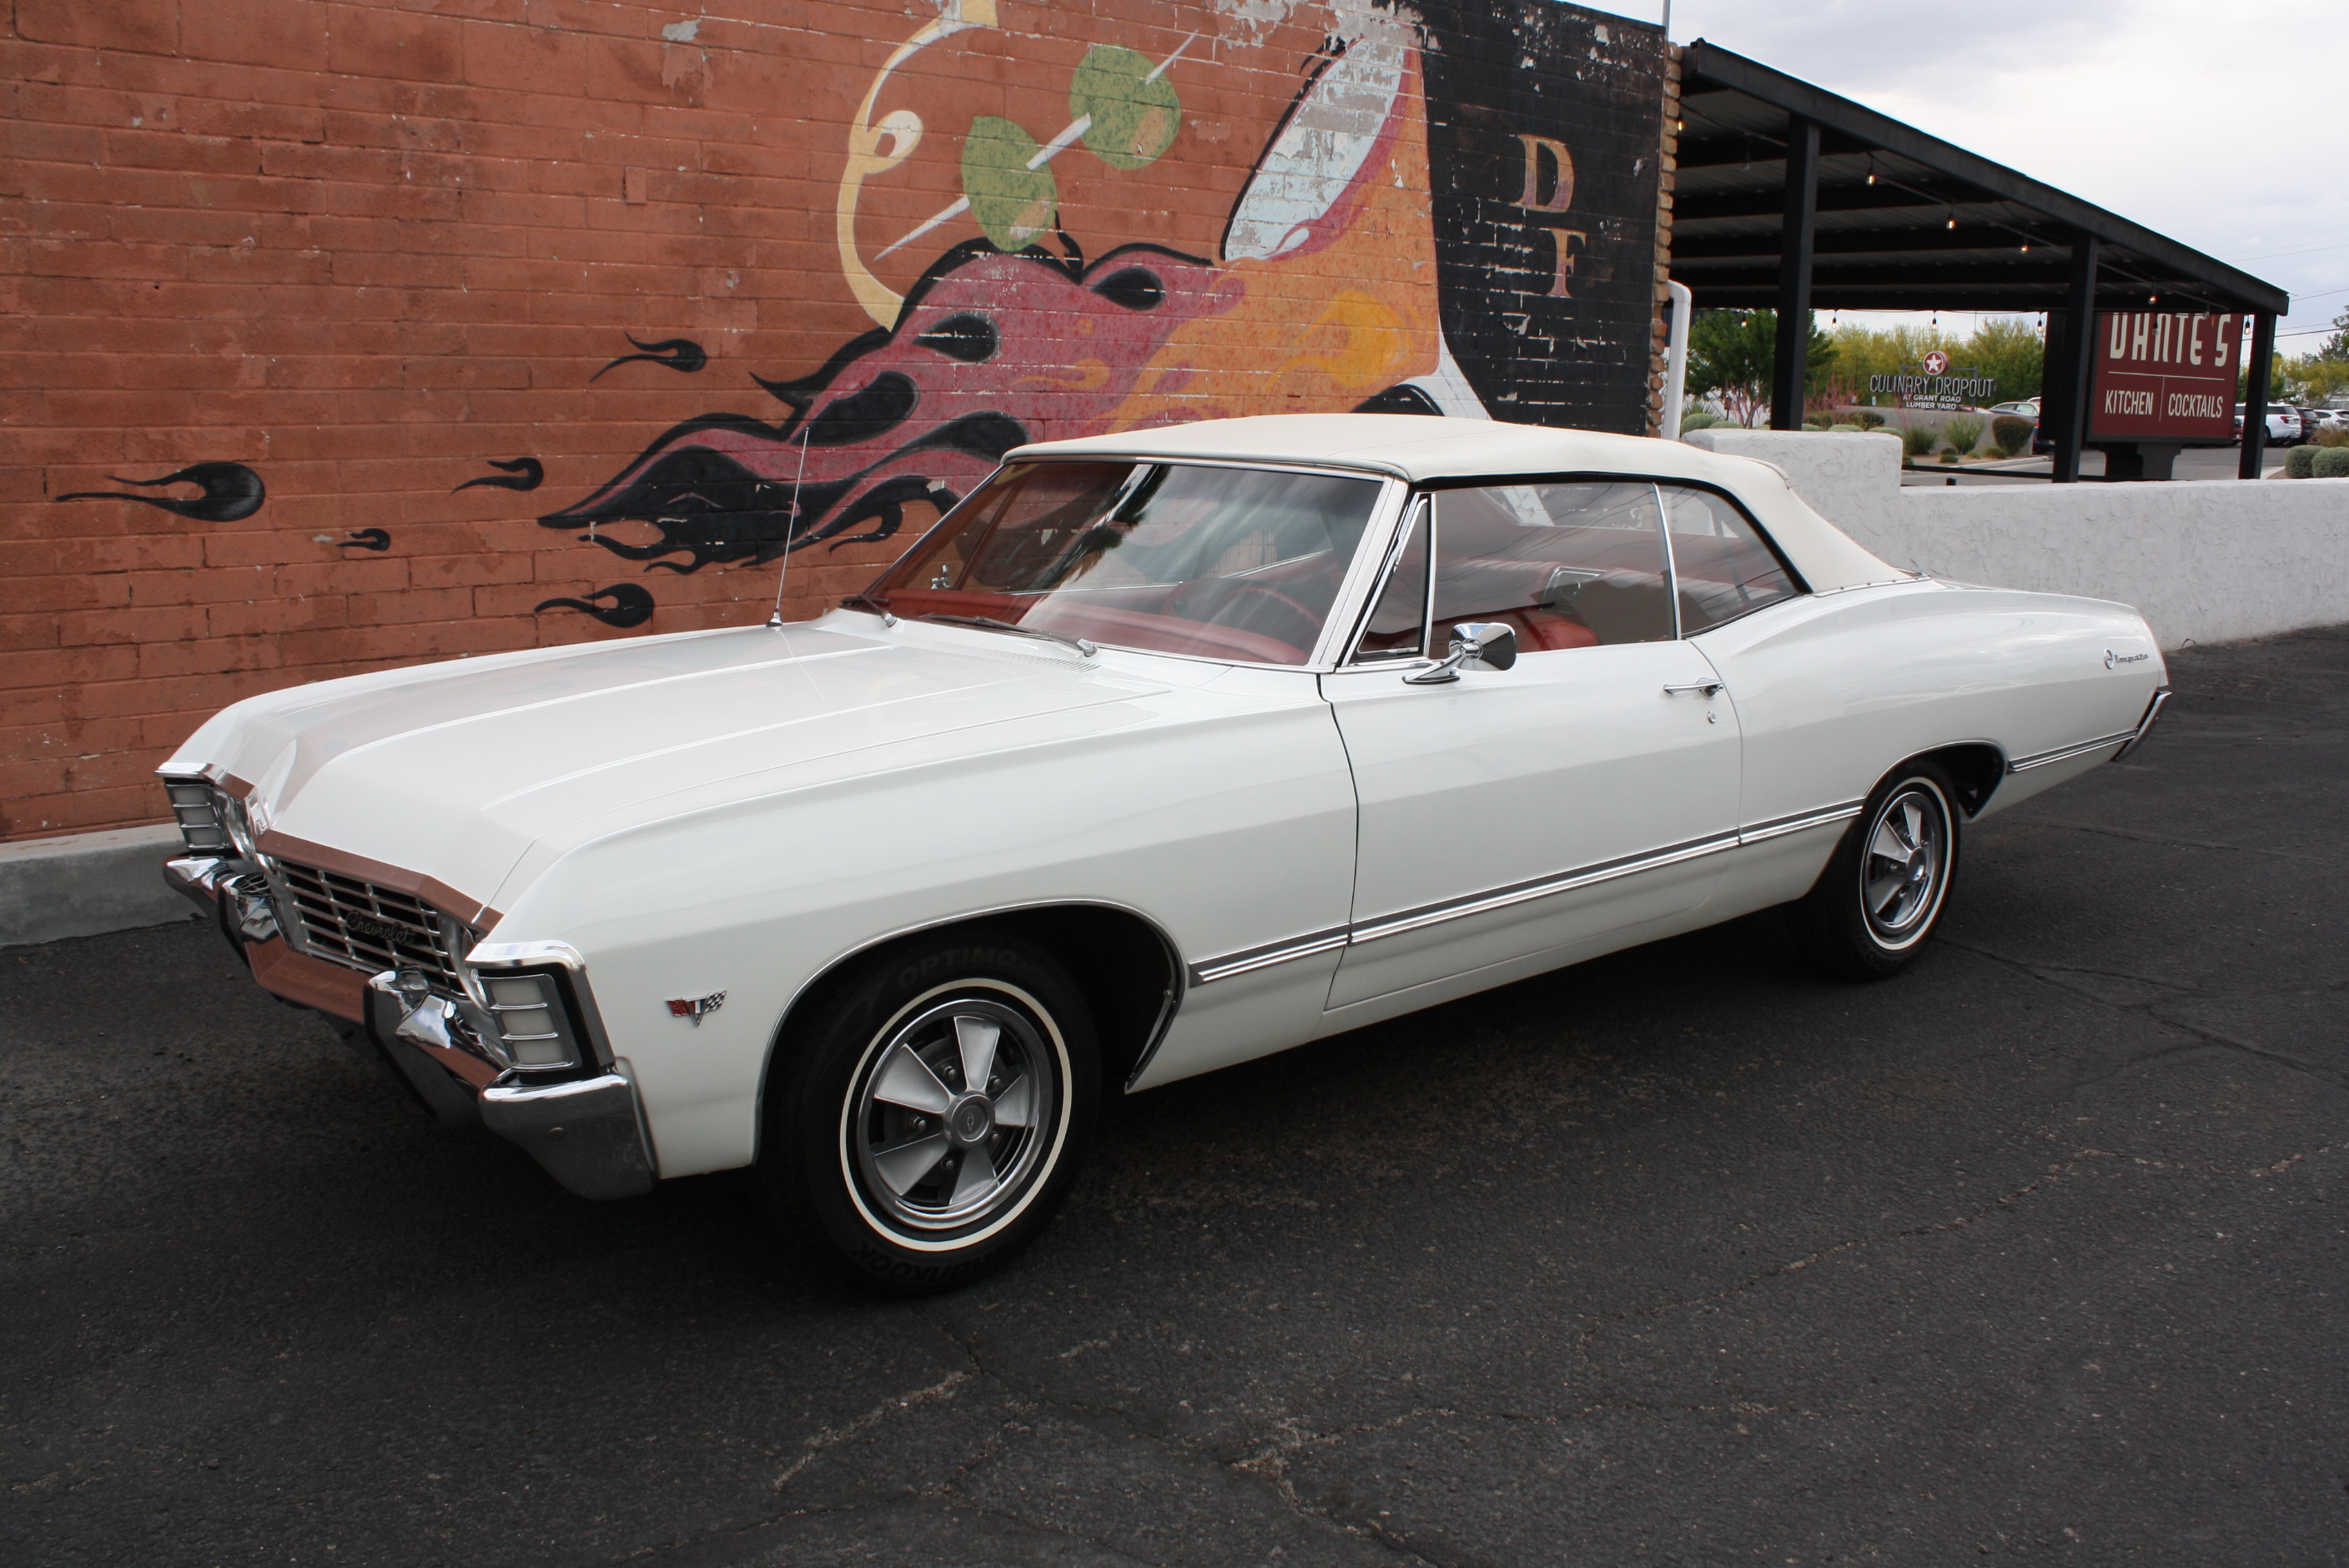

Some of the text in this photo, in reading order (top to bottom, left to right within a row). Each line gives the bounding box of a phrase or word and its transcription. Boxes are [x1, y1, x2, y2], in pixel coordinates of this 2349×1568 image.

[1509, 133, 1575, 213] D
[1547, 228, 1587, 299] F
[1870, 375, 1994, 397] CULINARY DROPOUT
[2105, 389, 2223, 418] KITCHEN COCKTAILS
[346, 910, 415, 944] Chevrolet
[898, 946, 1017, 989] OPTIMO
